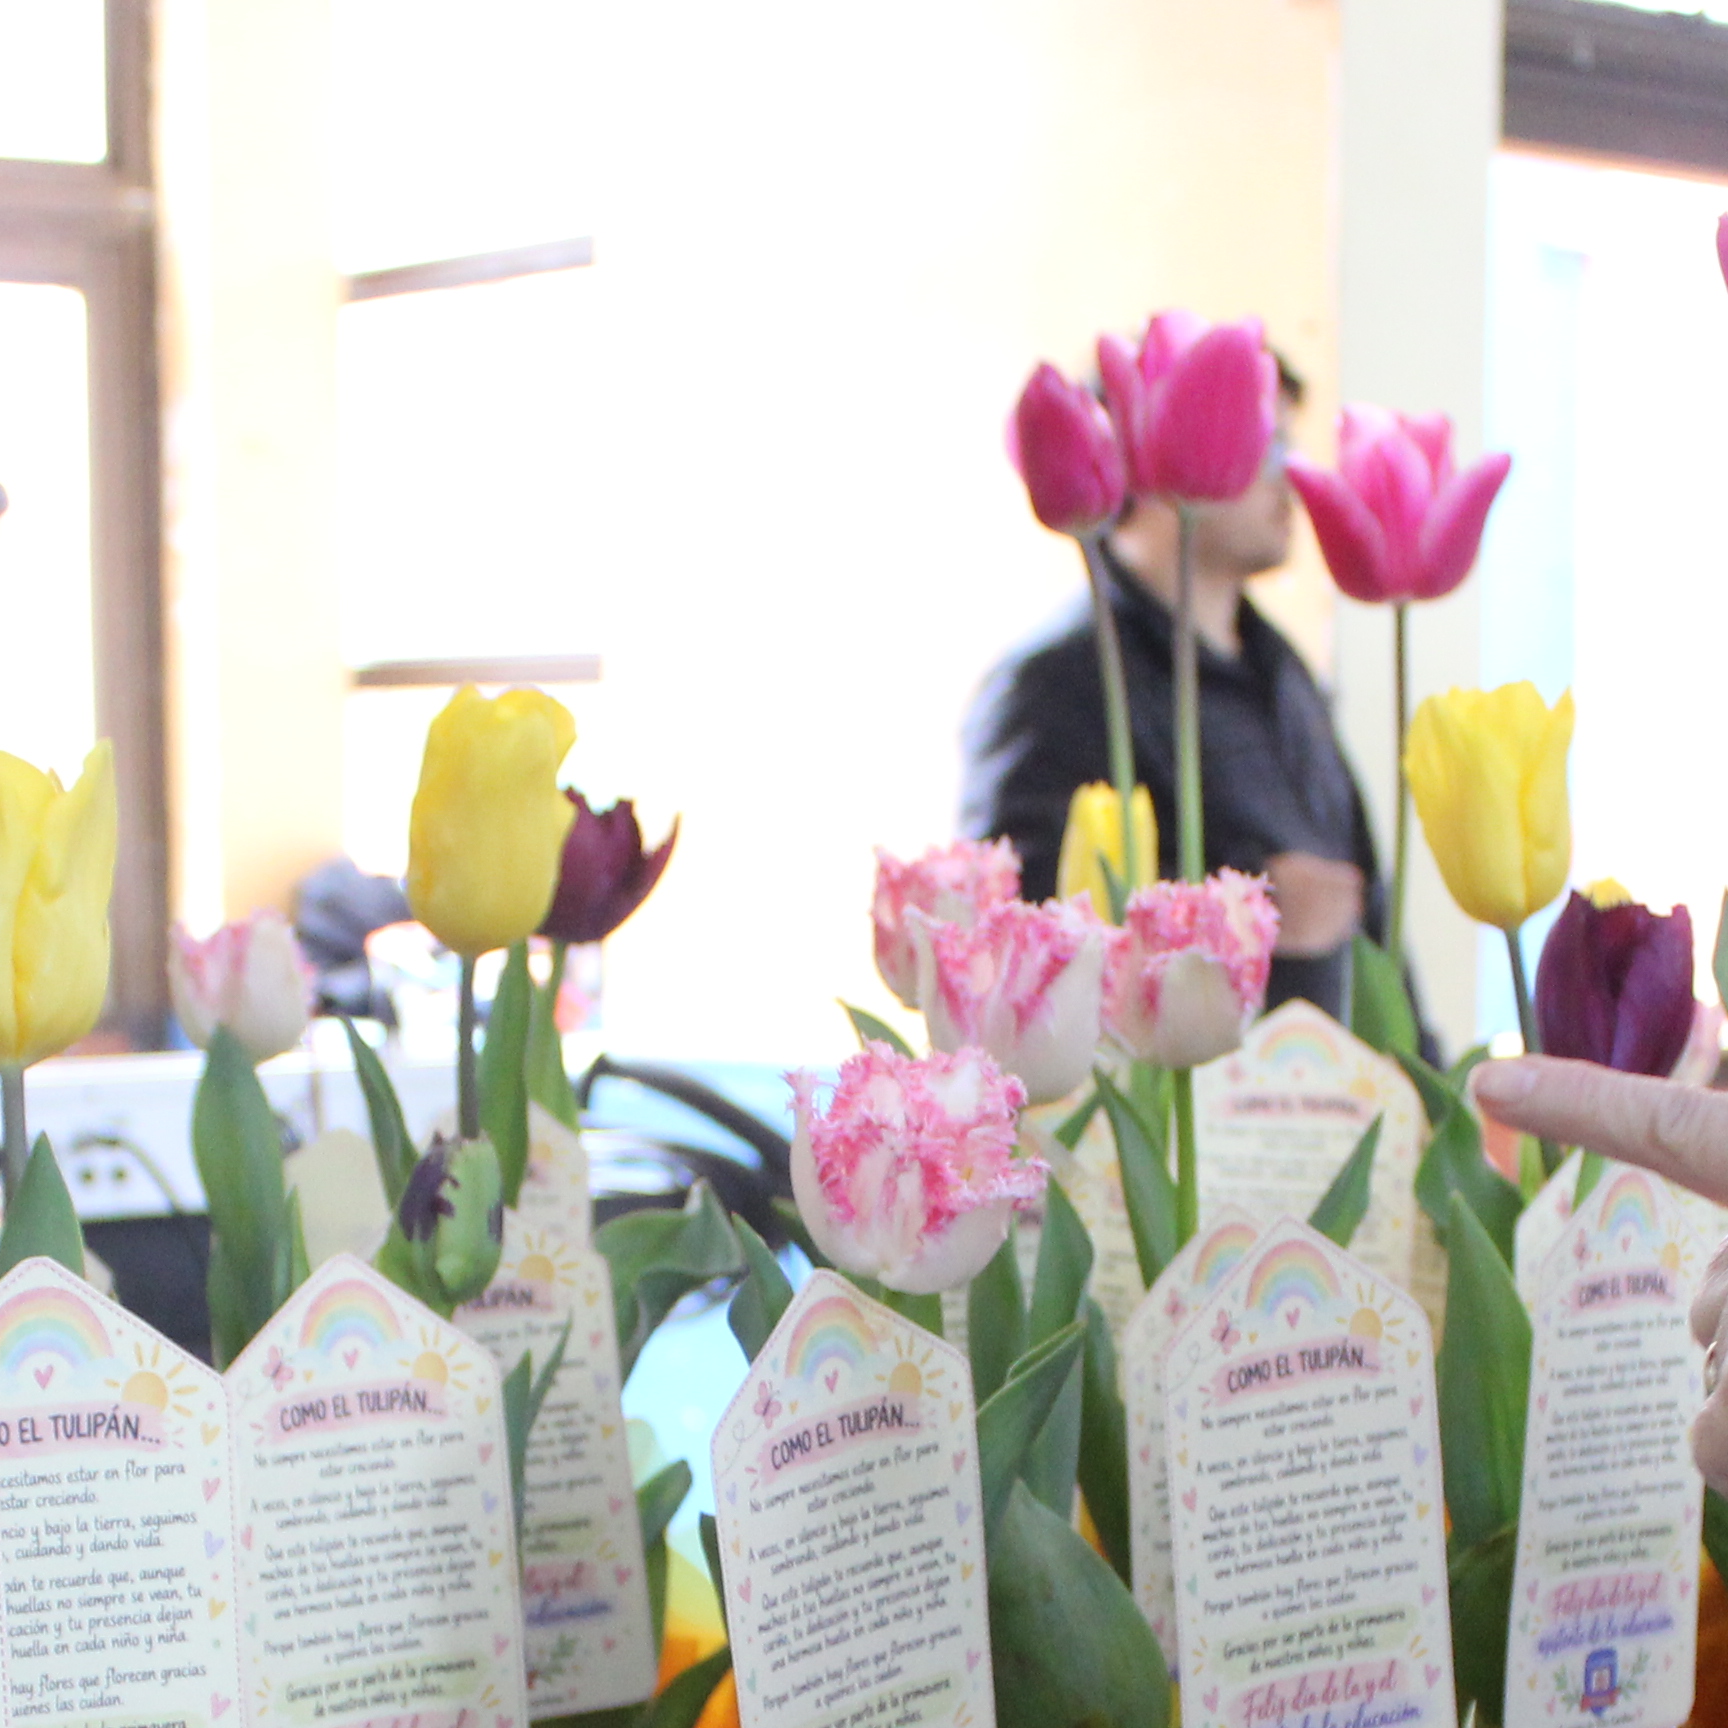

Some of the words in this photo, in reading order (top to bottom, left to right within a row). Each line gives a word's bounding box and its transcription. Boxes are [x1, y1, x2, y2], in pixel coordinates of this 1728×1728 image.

[1227, 1361, 1271, 1394] COMO
[1277, 1359, 1294, 1378] EL
[1298, 1338, 1378, 1373] TULIPÁN...
[19, 1423, 43, 1444] EL
[49, 1404, 160, 1444] TULIPÁN...
[282, 1400, 328, 1432] COMO
[334, 1399, 352, 1418] EL
[356, 1379, 441, 1414] TULIPÁN...
[772, 1431, 814, 1471] COMO
[819, 1426, 836, 1448] EL
[838, 1396, 920, 1438] TULIPÁN...
